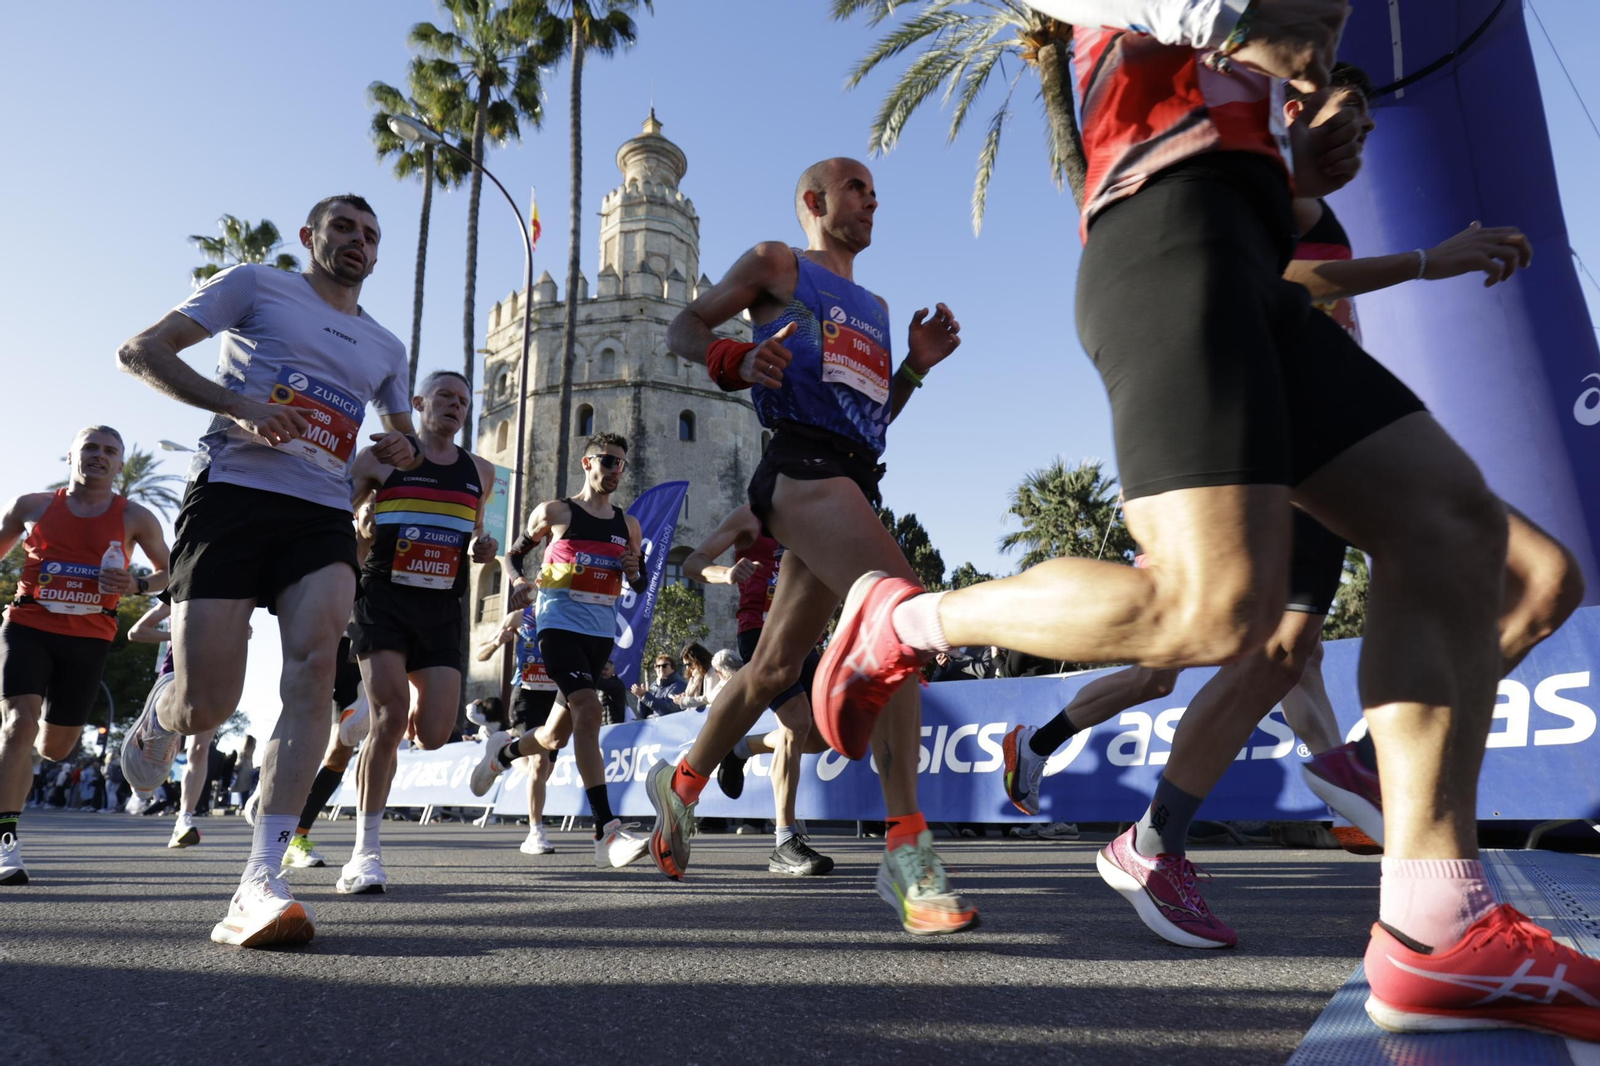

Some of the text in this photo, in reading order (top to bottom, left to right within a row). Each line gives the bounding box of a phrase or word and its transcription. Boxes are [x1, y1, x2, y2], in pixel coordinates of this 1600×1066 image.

[331, 329, 357, 345] TERREX
[850, 317, 883, 342] ZURICH
[313, 385, 358, 416] ZURICH
[310, 408, 332, 425] 399
[424, 531, 459, 544] ZURICH
[661, 523, 674, 545] body
[424, 548, 441, 559] 810
[656, 542, 667, 570] sound
[66, 566, 100, 576] ZURIC
[406, 559, 451, 576] JAVIER
[593, 571, 608, 580] 1277
[39, 589, 101, 604] EDUARDO
[644, 591, 654, 619] sound
